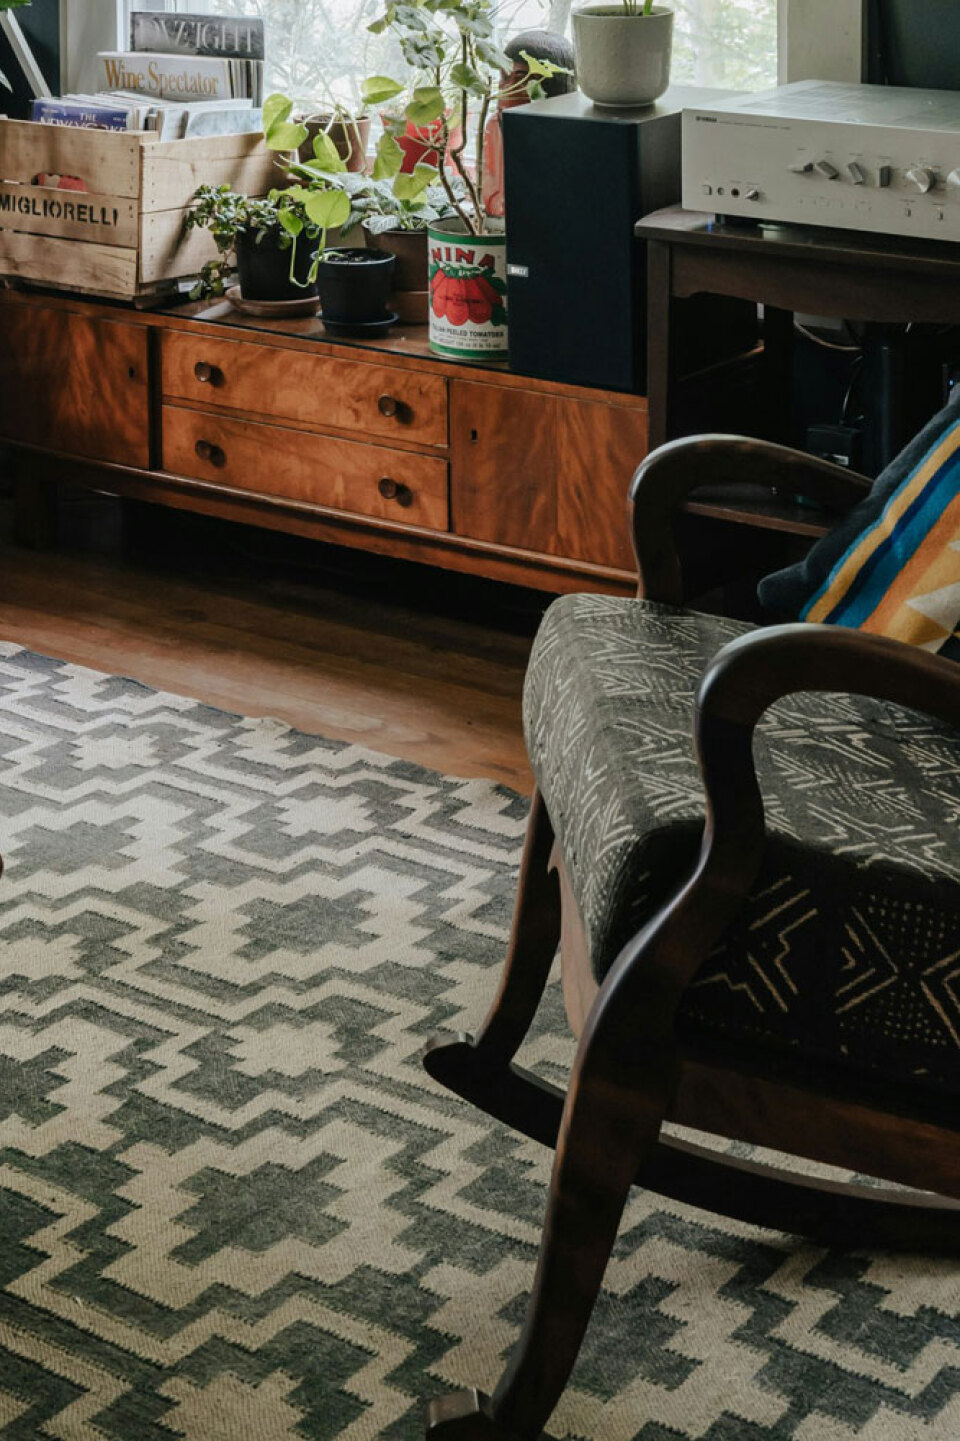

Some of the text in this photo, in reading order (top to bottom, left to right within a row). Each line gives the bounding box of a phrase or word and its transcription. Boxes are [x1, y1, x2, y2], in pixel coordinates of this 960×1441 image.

[104, 59, 219, 98] Wine Spectator
[80, 112, 96, 121] THE
[431, 247, 495, 270] NINA
